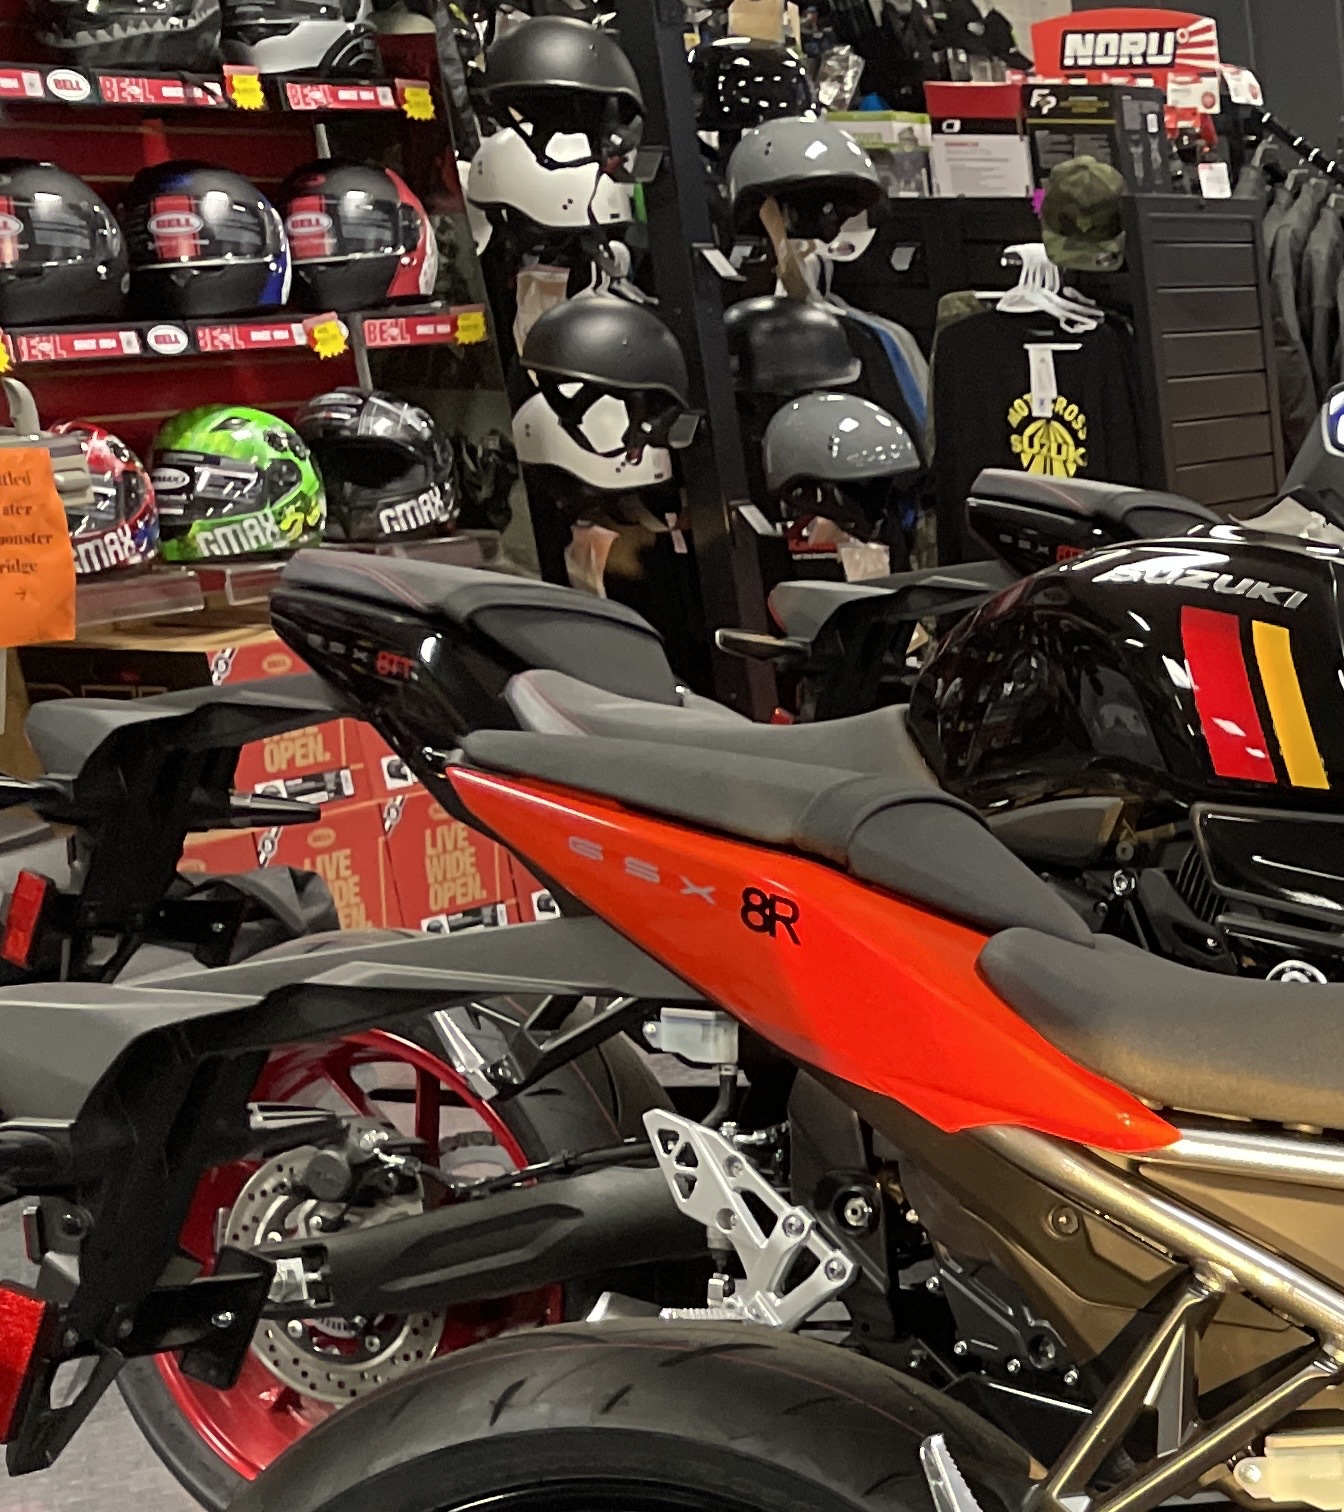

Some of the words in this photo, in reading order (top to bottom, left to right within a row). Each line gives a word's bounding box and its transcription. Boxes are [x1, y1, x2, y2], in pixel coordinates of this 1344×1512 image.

[1062, 31, 1175, 66] NORU
[196, 508, 280, 558] GMAX
[378, 489, 445, 534] GMAX
[75, 523, 137, 574] MAX
[1102, 562, 1308, 609] SUZUKI
[263, 732, 331, 774] OPEN.
[425, 823, 469, 851] LIVE
[426, 847, 477, 884] WIDE
[429, 874, 487, 912] OPEN.
[741, 886, 802, 947] 8R
